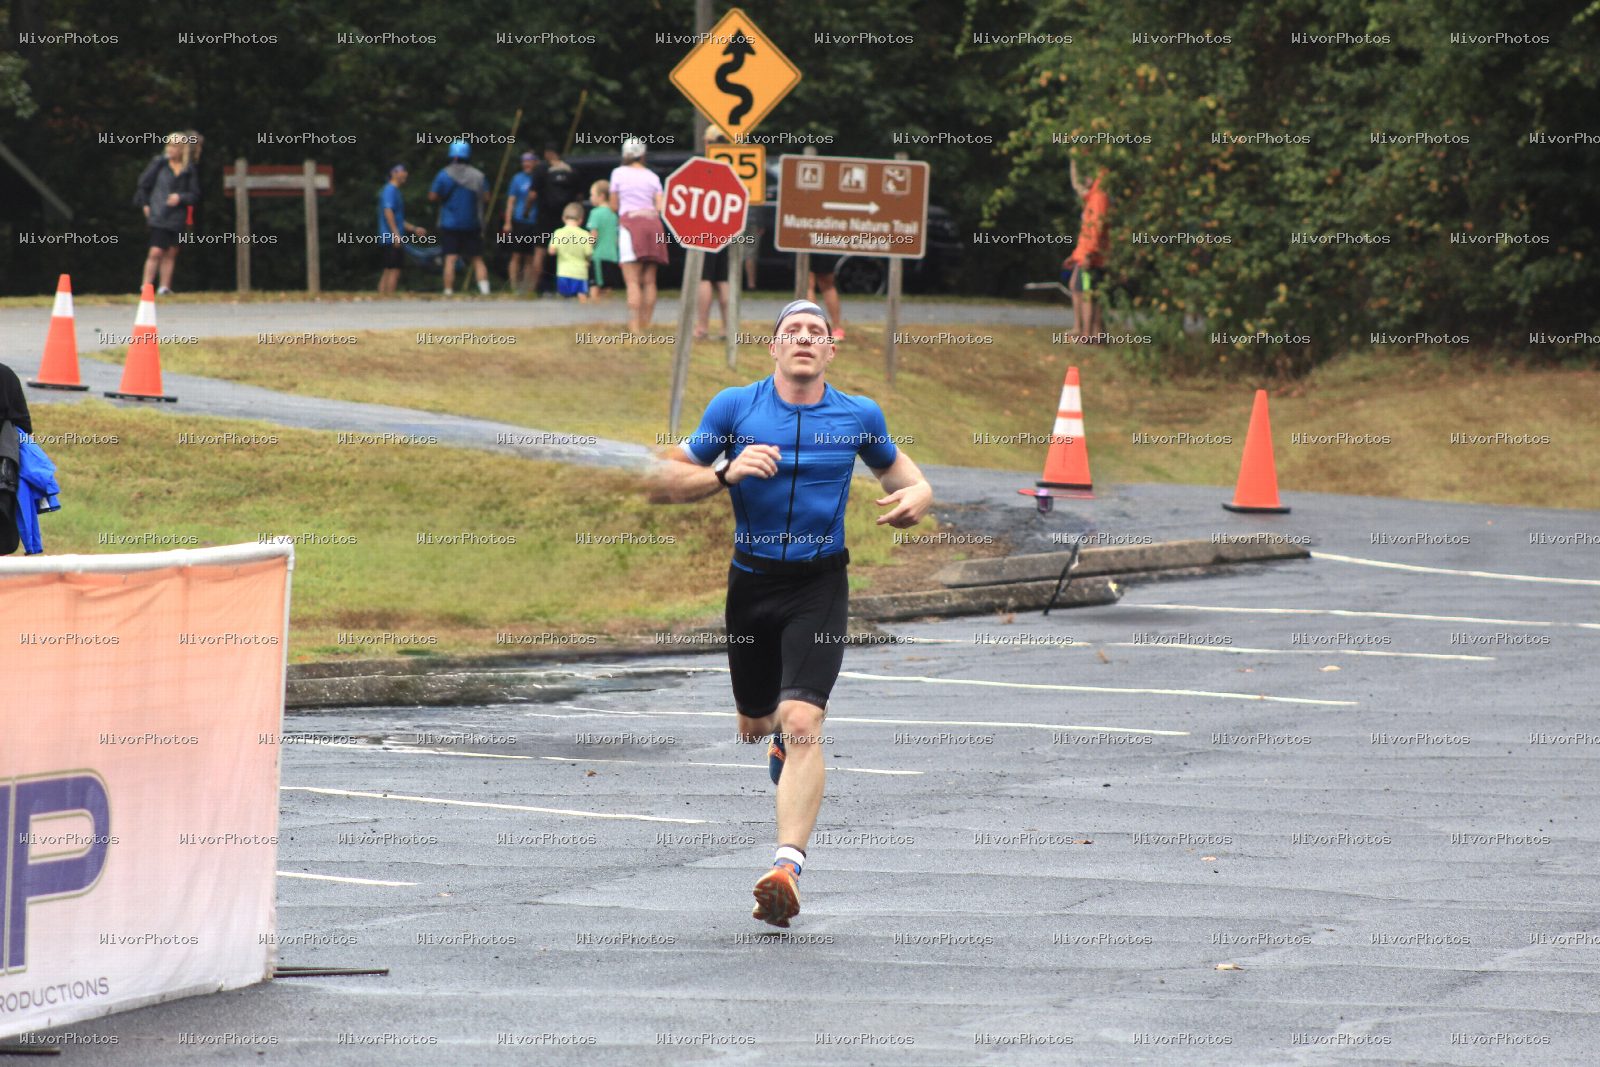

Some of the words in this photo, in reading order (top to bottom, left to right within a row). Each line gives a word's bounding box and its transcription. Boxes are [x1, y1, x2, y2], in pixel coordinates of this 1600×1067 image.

[668, 184, 743, 225] STOP
[783, 214, 847, 231] Muscadine
[850, 218, 890, 233] Nature
[893, 219, 919, 235] Trail
[0, 768, 111, 974] P
